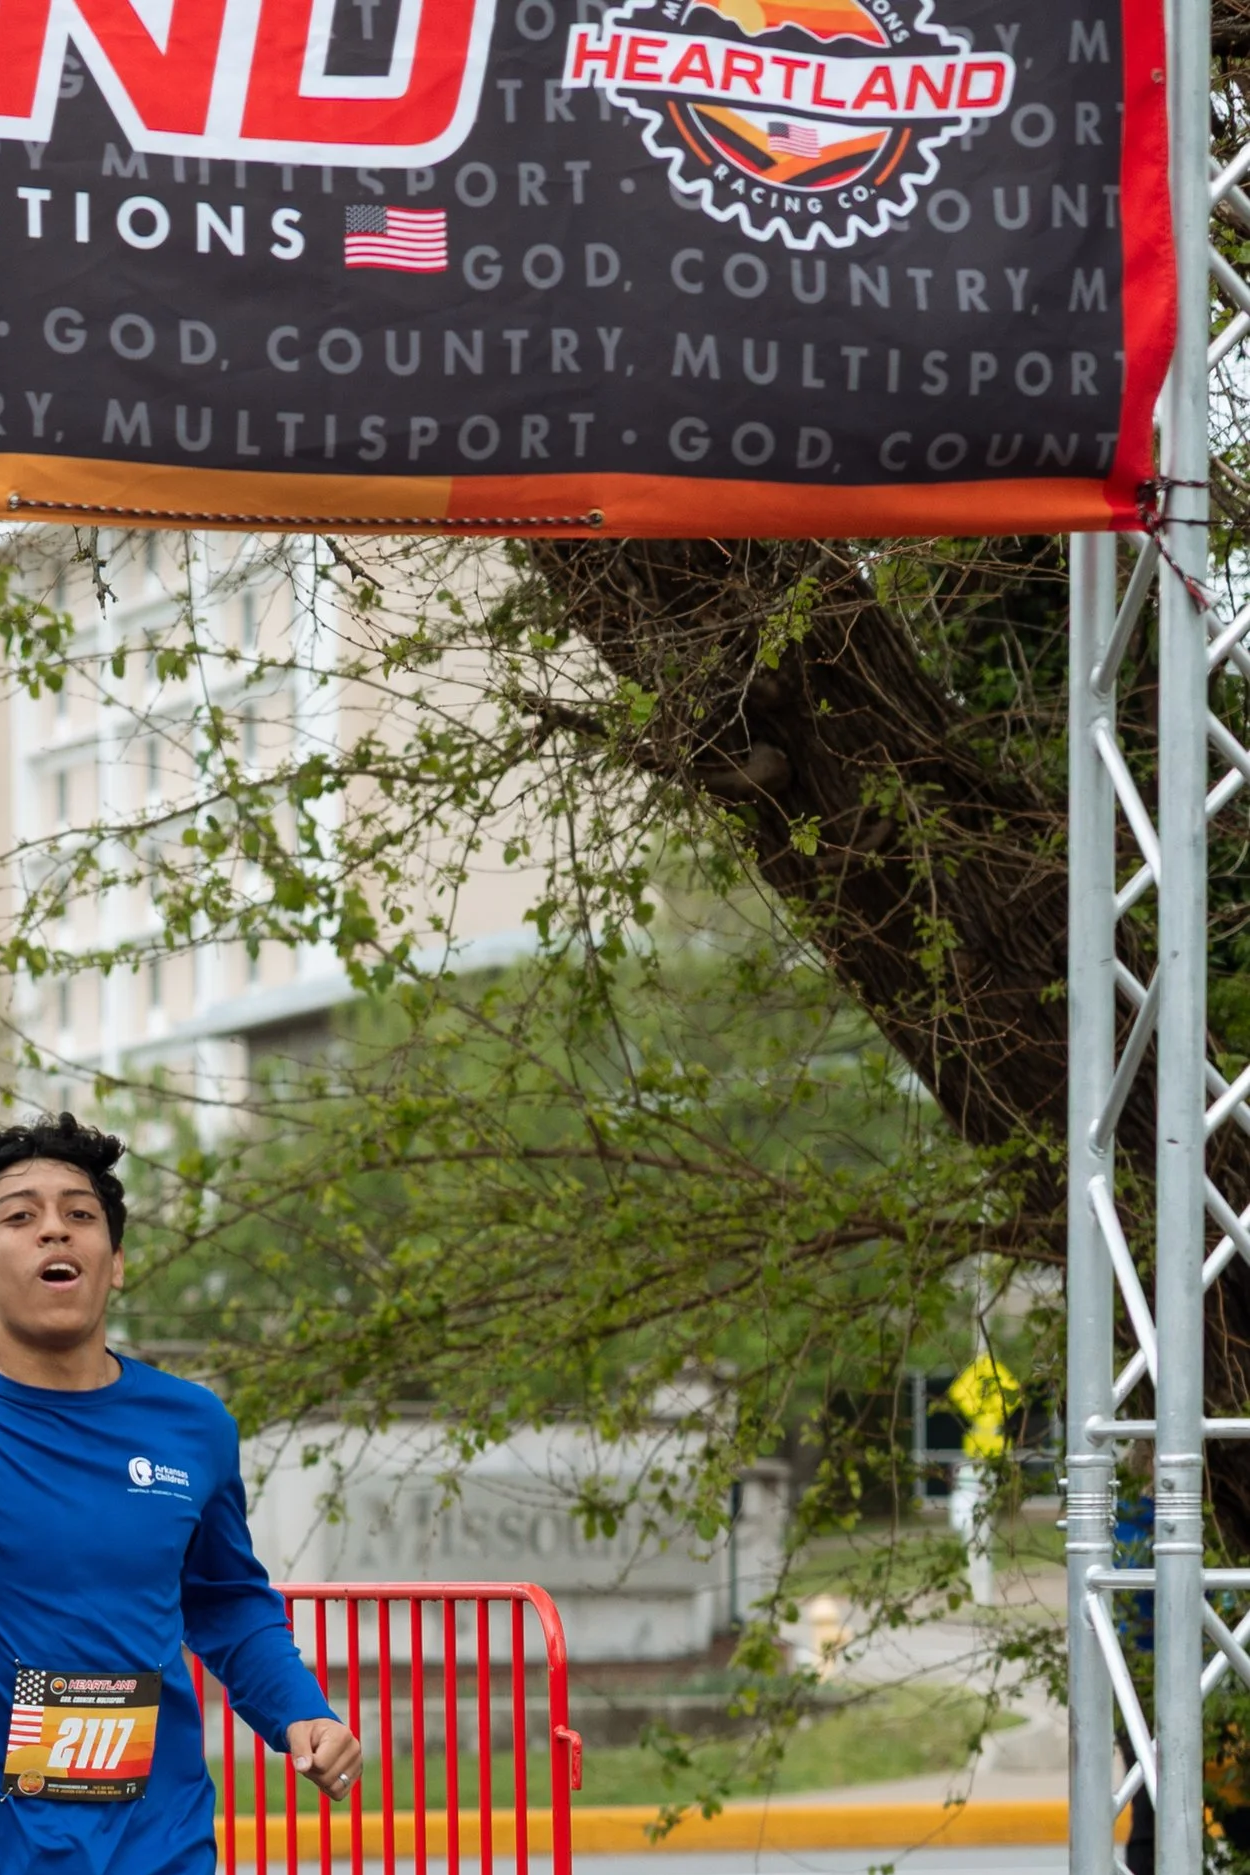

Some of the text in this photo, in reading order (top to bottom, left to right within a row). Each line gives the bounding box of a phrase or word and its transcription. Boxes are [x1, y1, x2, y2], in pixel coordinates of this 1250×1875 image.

[570, 31, 1008, 112] HEARTLAND
[713, 163, 823, 215] RACING
[462, 243, 633, 292] GOD,
[670, 248, 1039, 315] COUNTRY,
[43, 307, 229, 371] GOD,
[266, 326, 634, 377] COUNTRY,
[102, 398, 594, 461] MULTISPORT
[668, 416, 841, 474] GOD,
[154, 1464, 189, 1479] Arkansas
[68, 1678, 138, 1691] HEARTLAND
[47, 1717, 136, 1770] 2117
